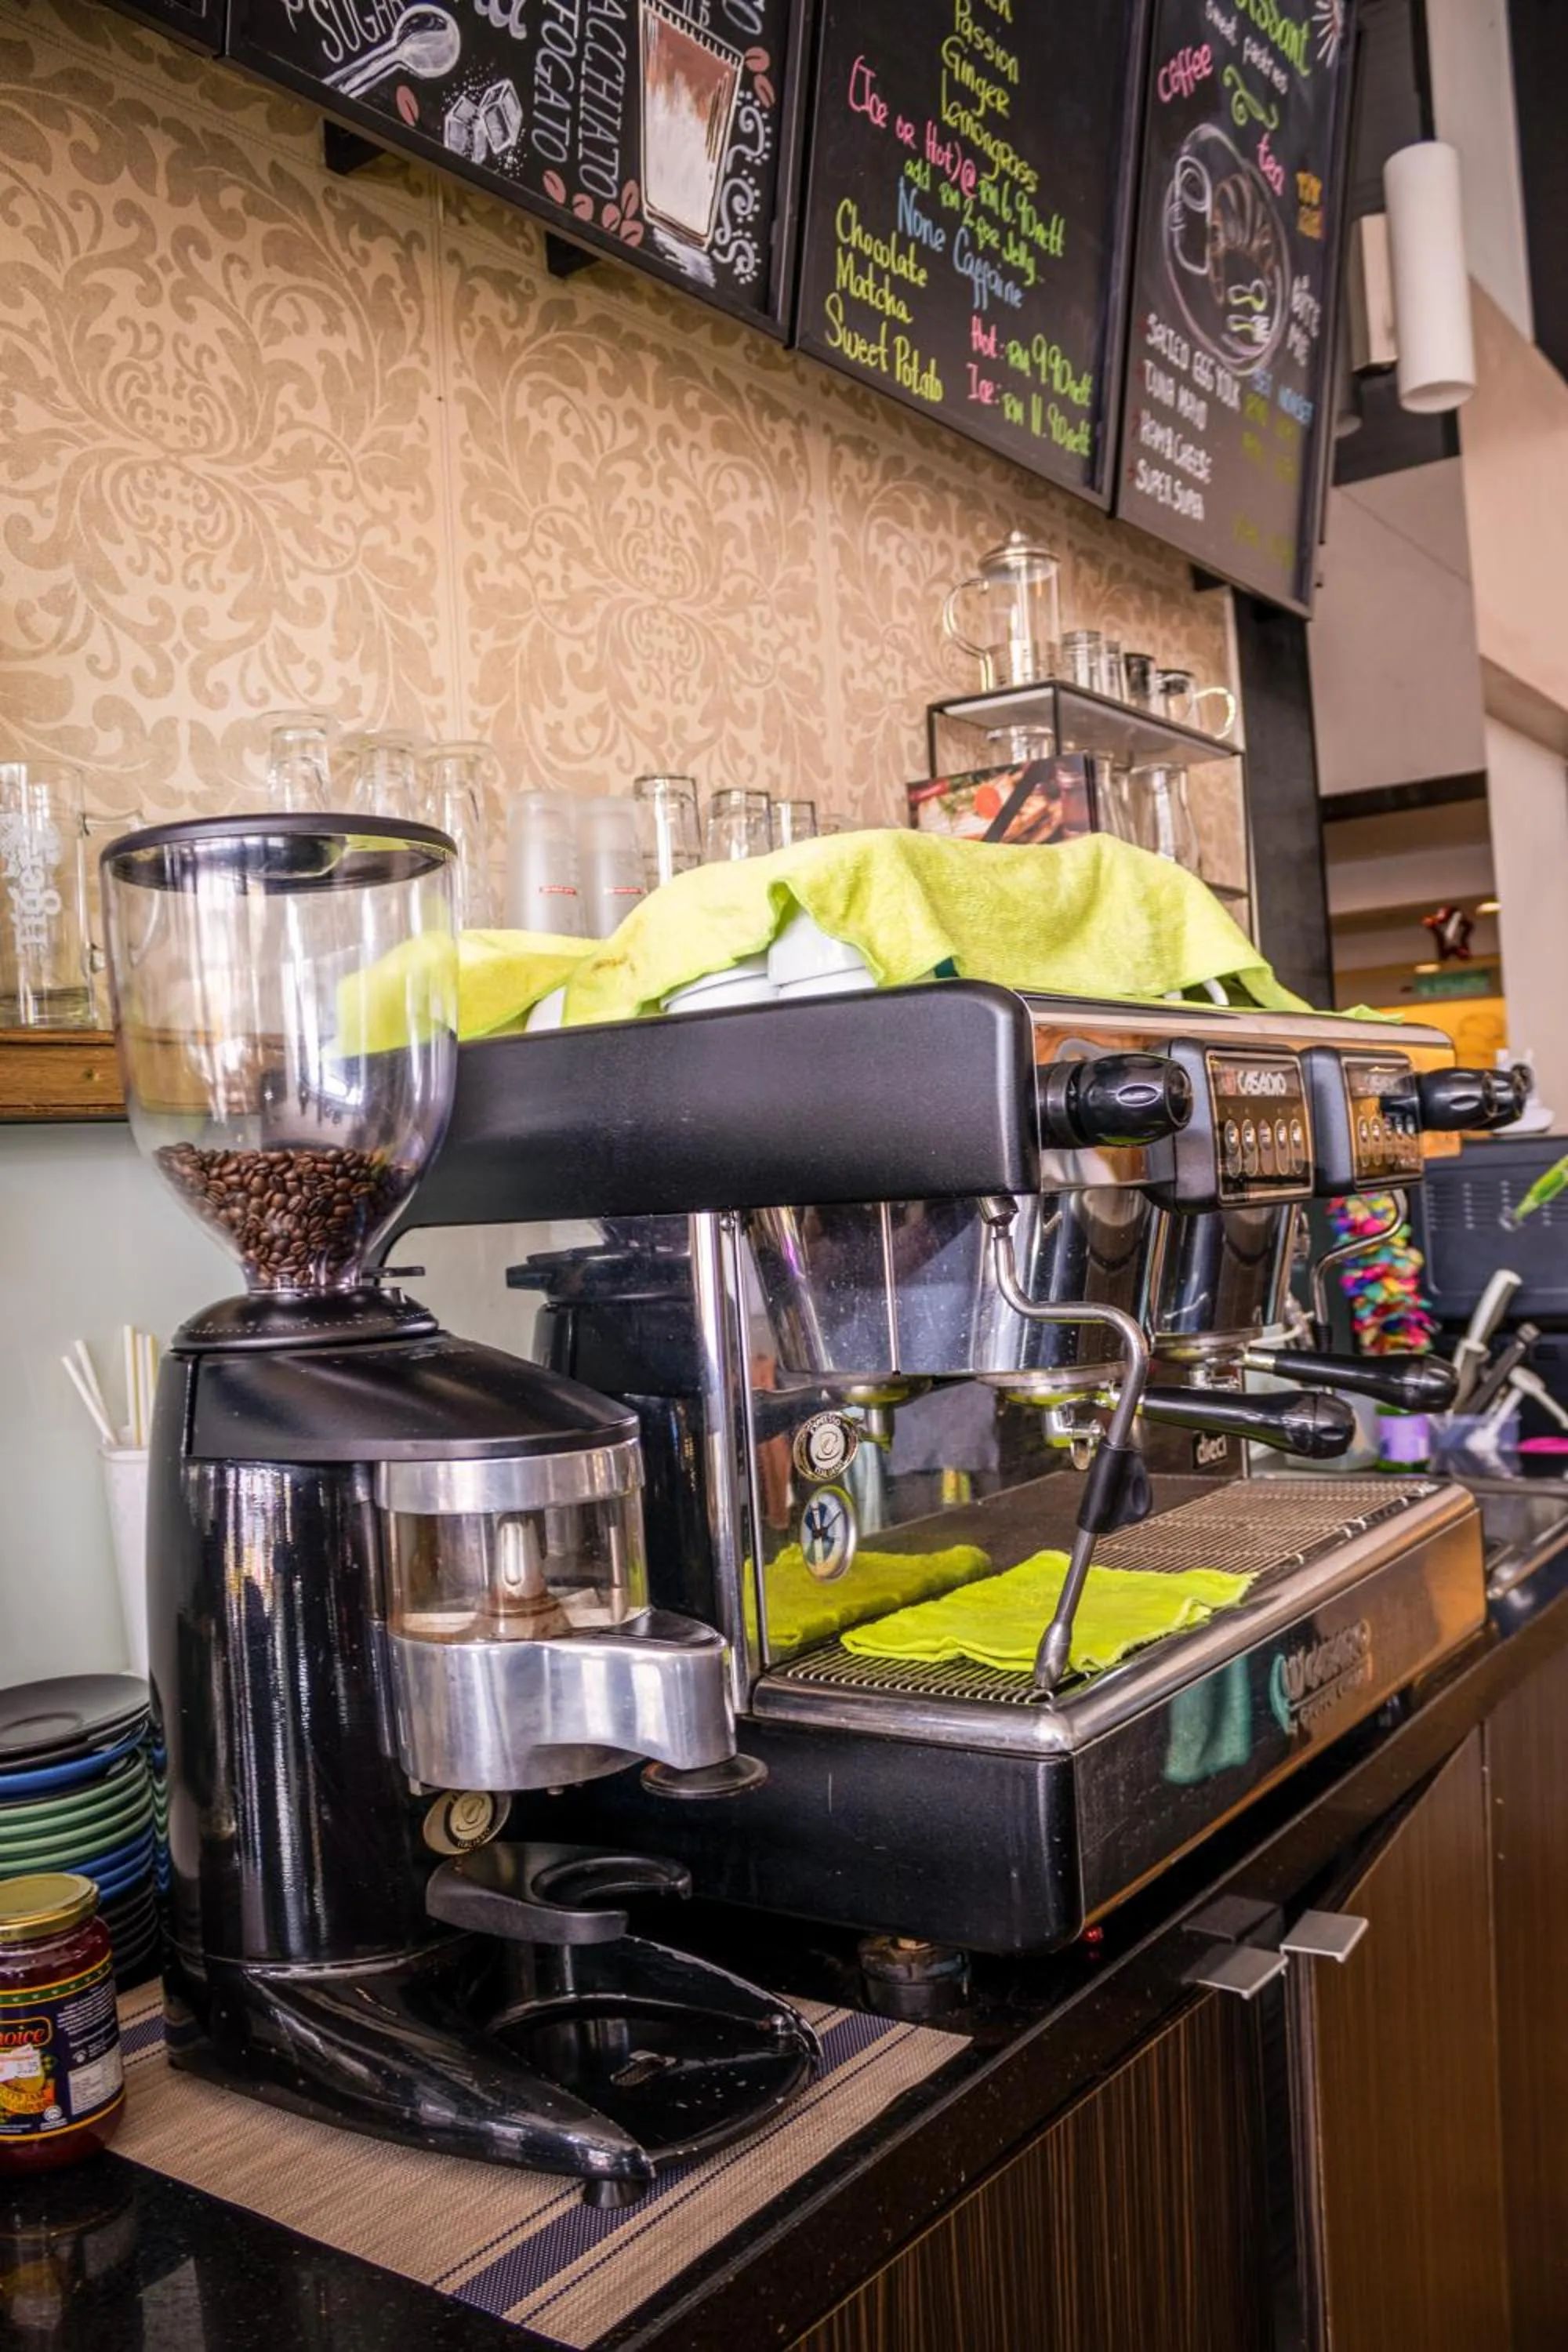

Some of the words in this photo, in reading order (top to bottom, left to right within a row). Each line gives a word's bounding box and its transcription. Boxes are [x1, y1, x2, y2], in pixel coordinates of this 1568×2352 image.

[532, 0, 581, 163] FOGATO
[956, 0, 1019, 84] Passion
[898, 175, 946, 252] None
[904, 158, 931, 192] add
[836, 198, 928, 288] Chocolate
[836, 245, 914, 324] Matcha
[825, 292, 889, 372] Sweet
[894, 336, 943, 402] Potato
